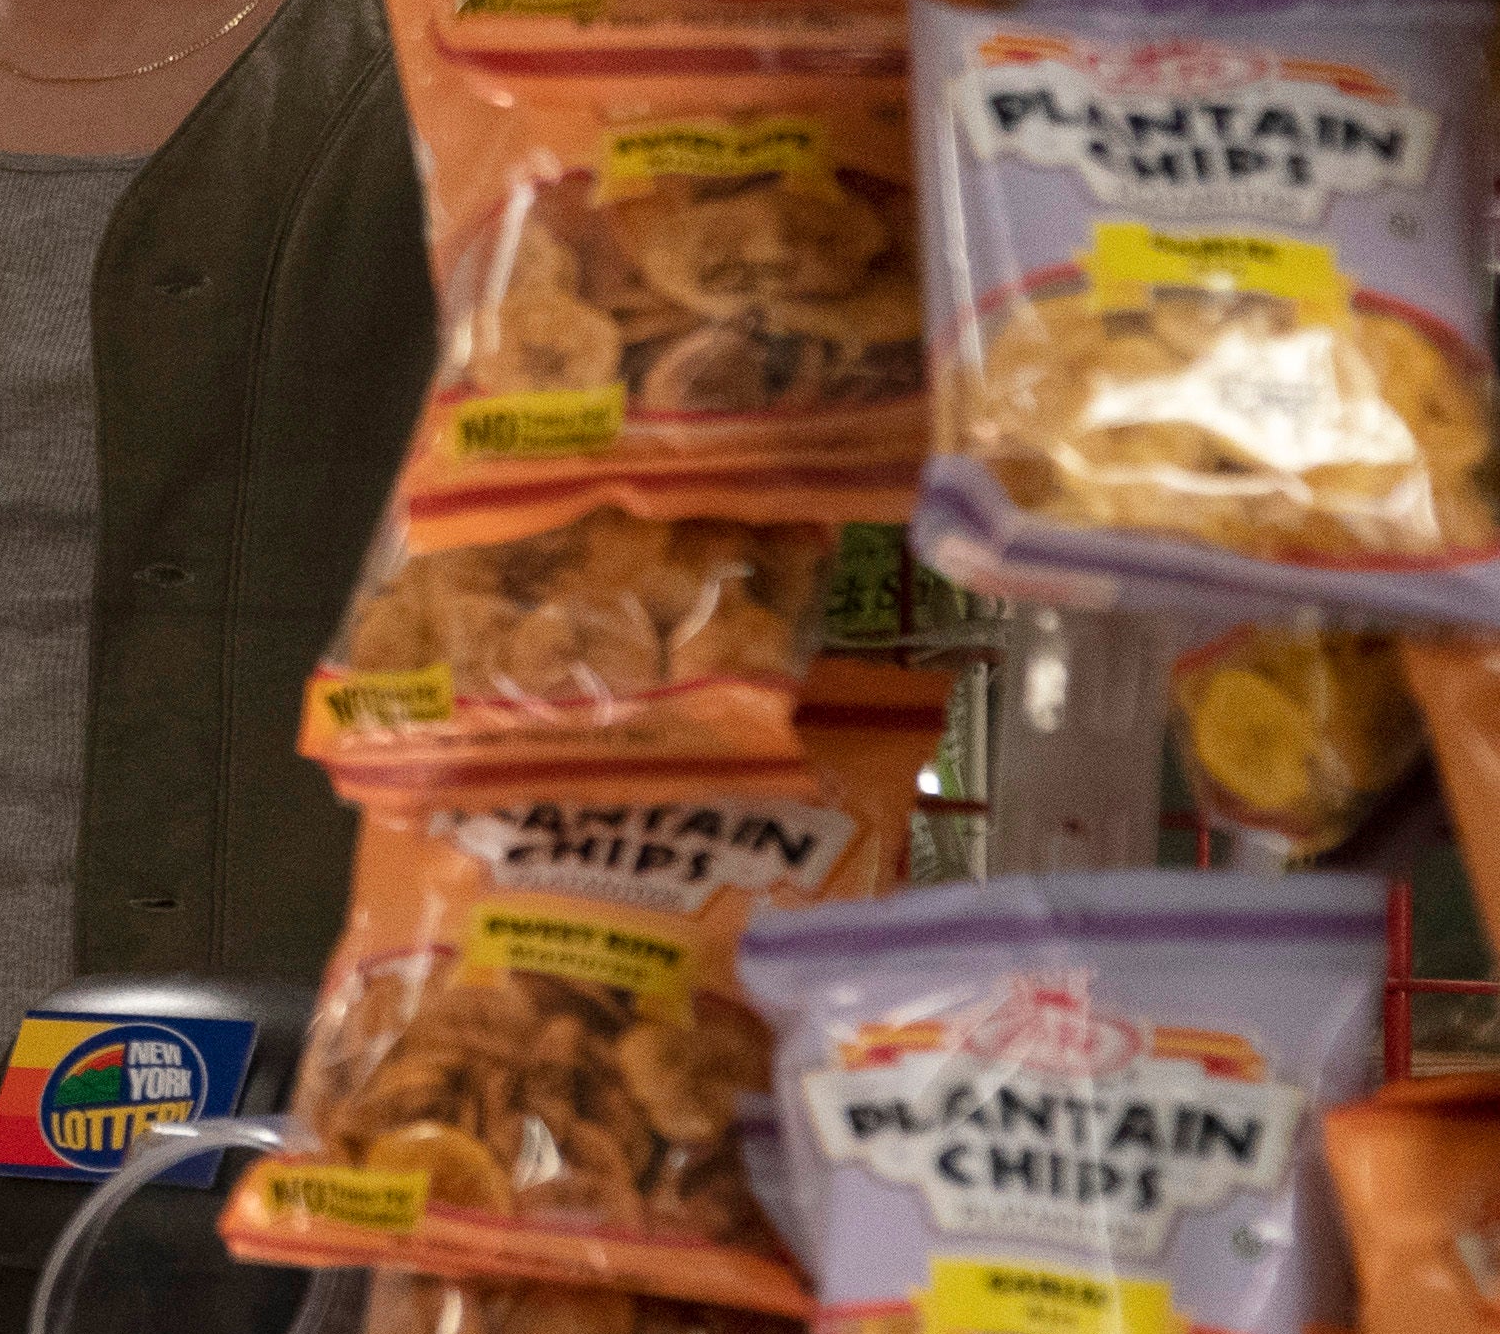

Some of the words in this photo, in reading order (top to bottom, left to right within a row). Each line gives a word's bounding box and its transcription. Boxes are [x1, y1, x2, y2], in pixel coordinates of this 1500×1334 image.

[127, 1040, 182, 1067] NEW
[128, 1068, 193, 1102] YORK
[934, 1141, 1164, 1215] CHIPS
